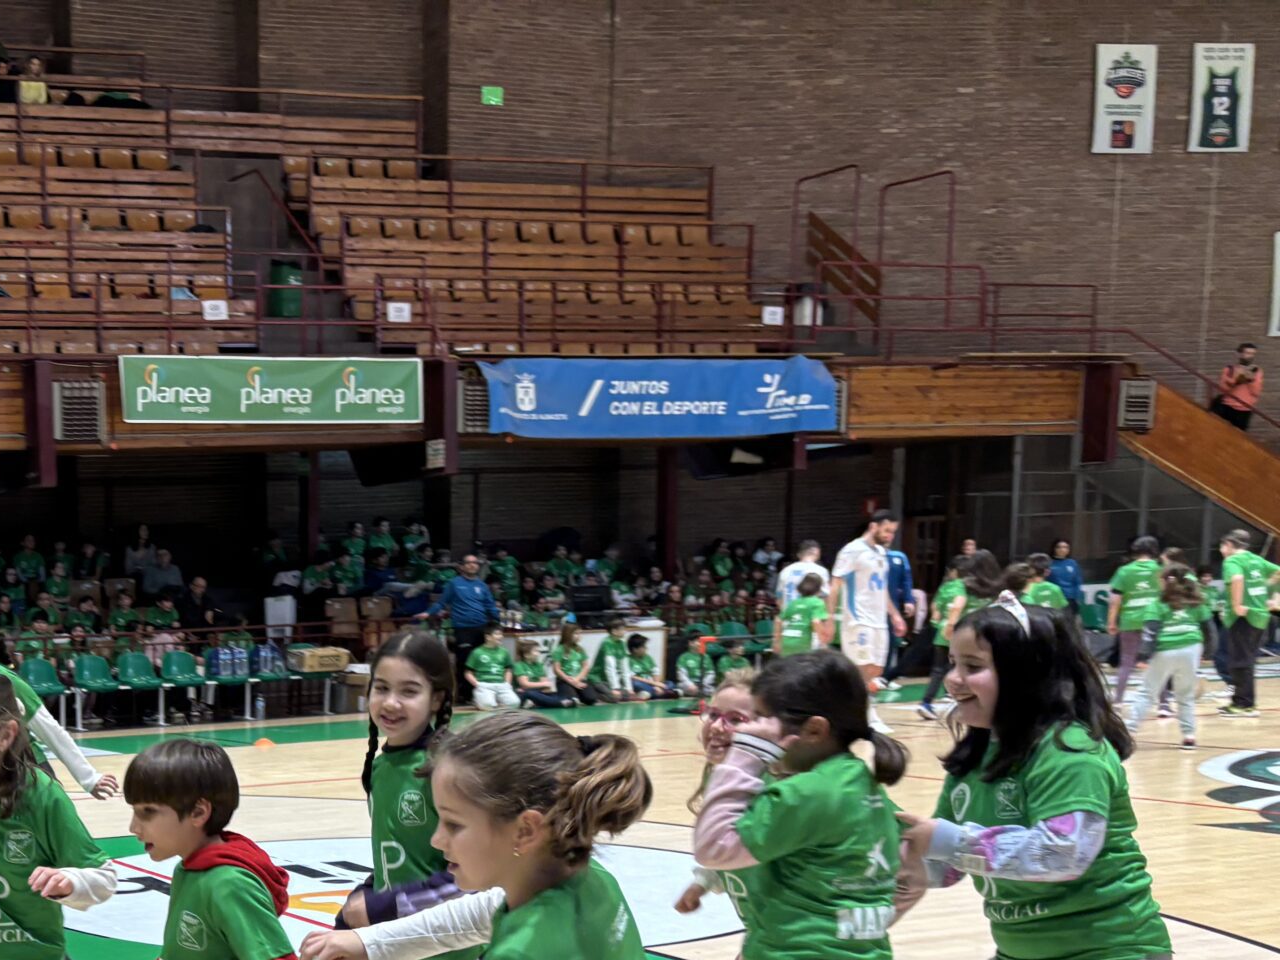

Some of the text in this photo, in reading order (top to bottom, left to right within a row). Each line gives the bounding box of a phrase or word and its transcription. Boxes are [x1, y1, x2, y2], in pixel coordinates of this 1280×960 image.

[1211, 96, 1230, 115] 12
[136, 371, 211, 412] planea
[240, 374, 312, 413] planea
[335, 374, 405, 413] planea
[609, 380, 669, 395] JUNTOS
[609, 401, 641, 415] CON
[642, 401, 661, 415] EL
[663, 401, 728, 415] DEPORTE
